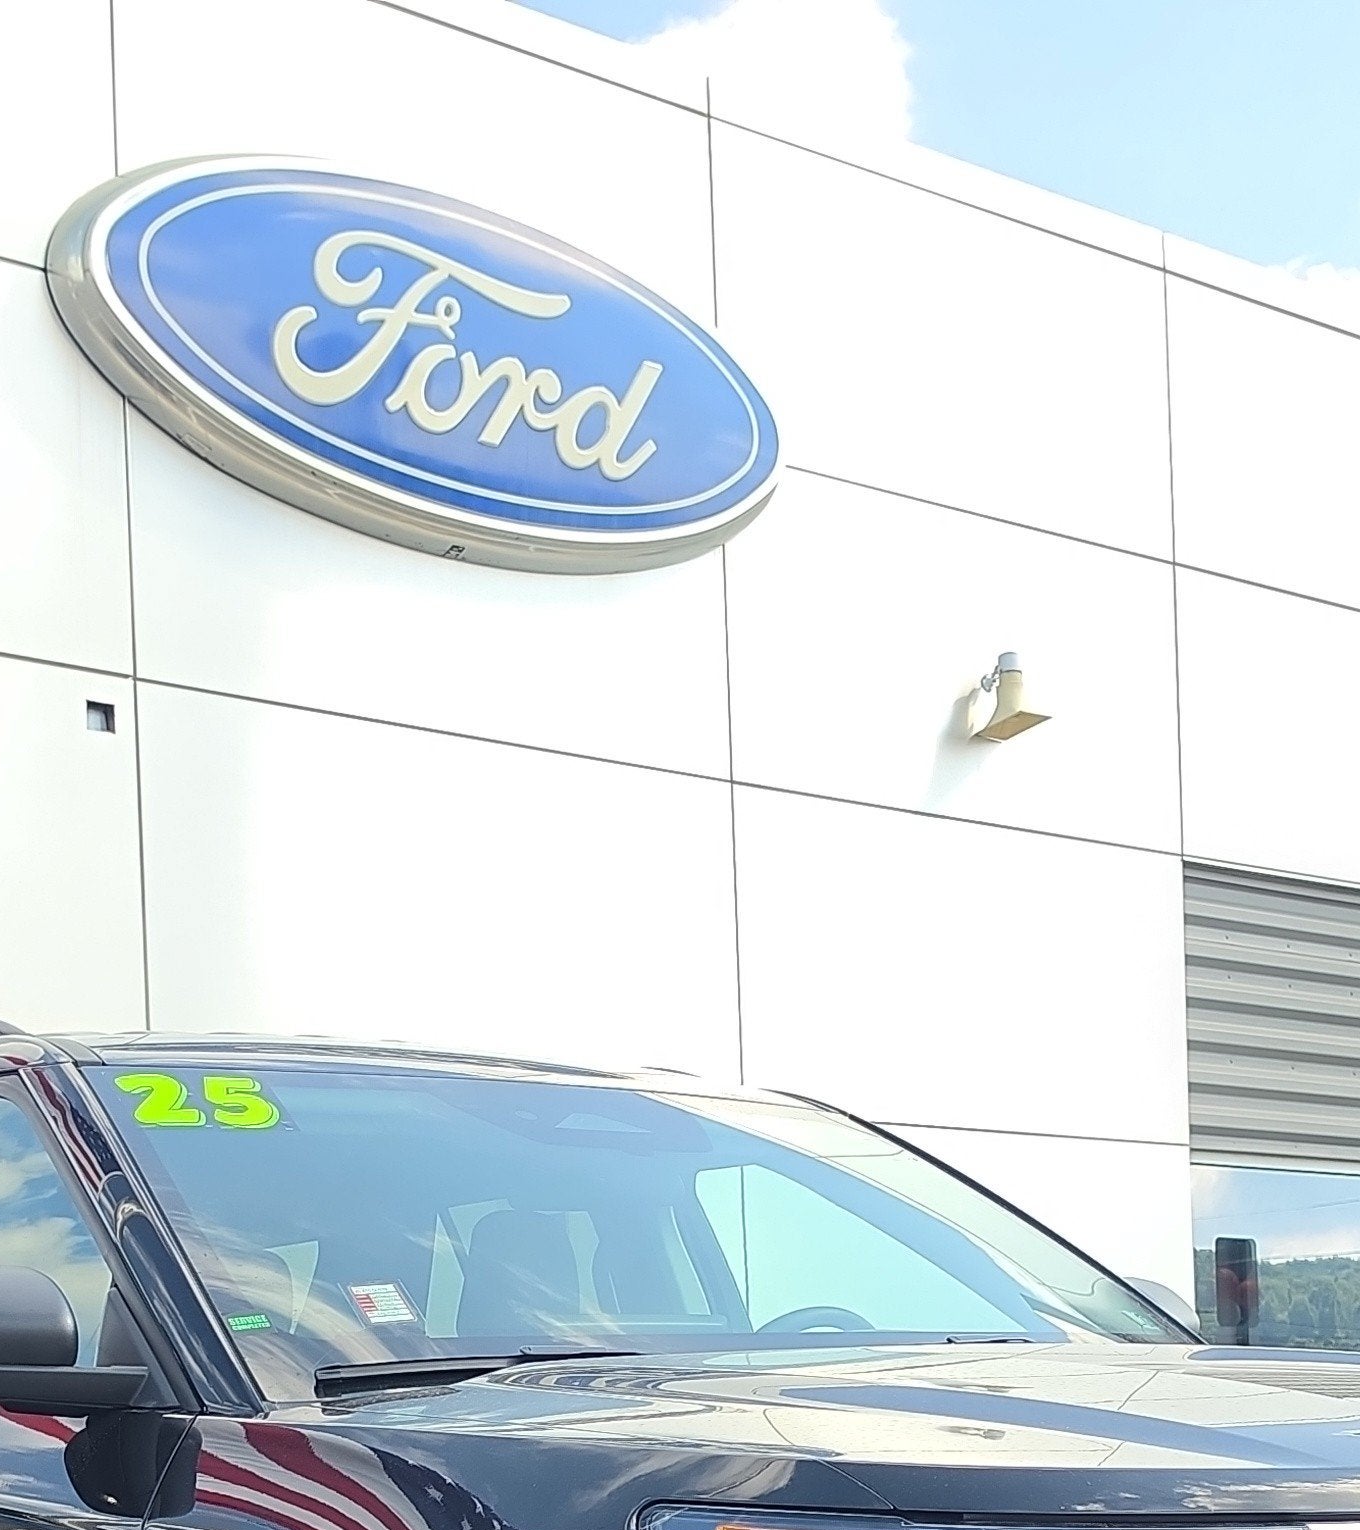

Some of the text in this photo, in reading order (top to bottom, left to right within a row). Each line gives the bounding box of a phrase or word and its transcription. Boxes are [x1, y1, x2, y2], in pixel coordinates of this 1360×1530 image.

[273, 229, 663, 481] Ford
[114, 1073, 281, 1130] 25
[227, 1315, 268, 1326] SERVICE
